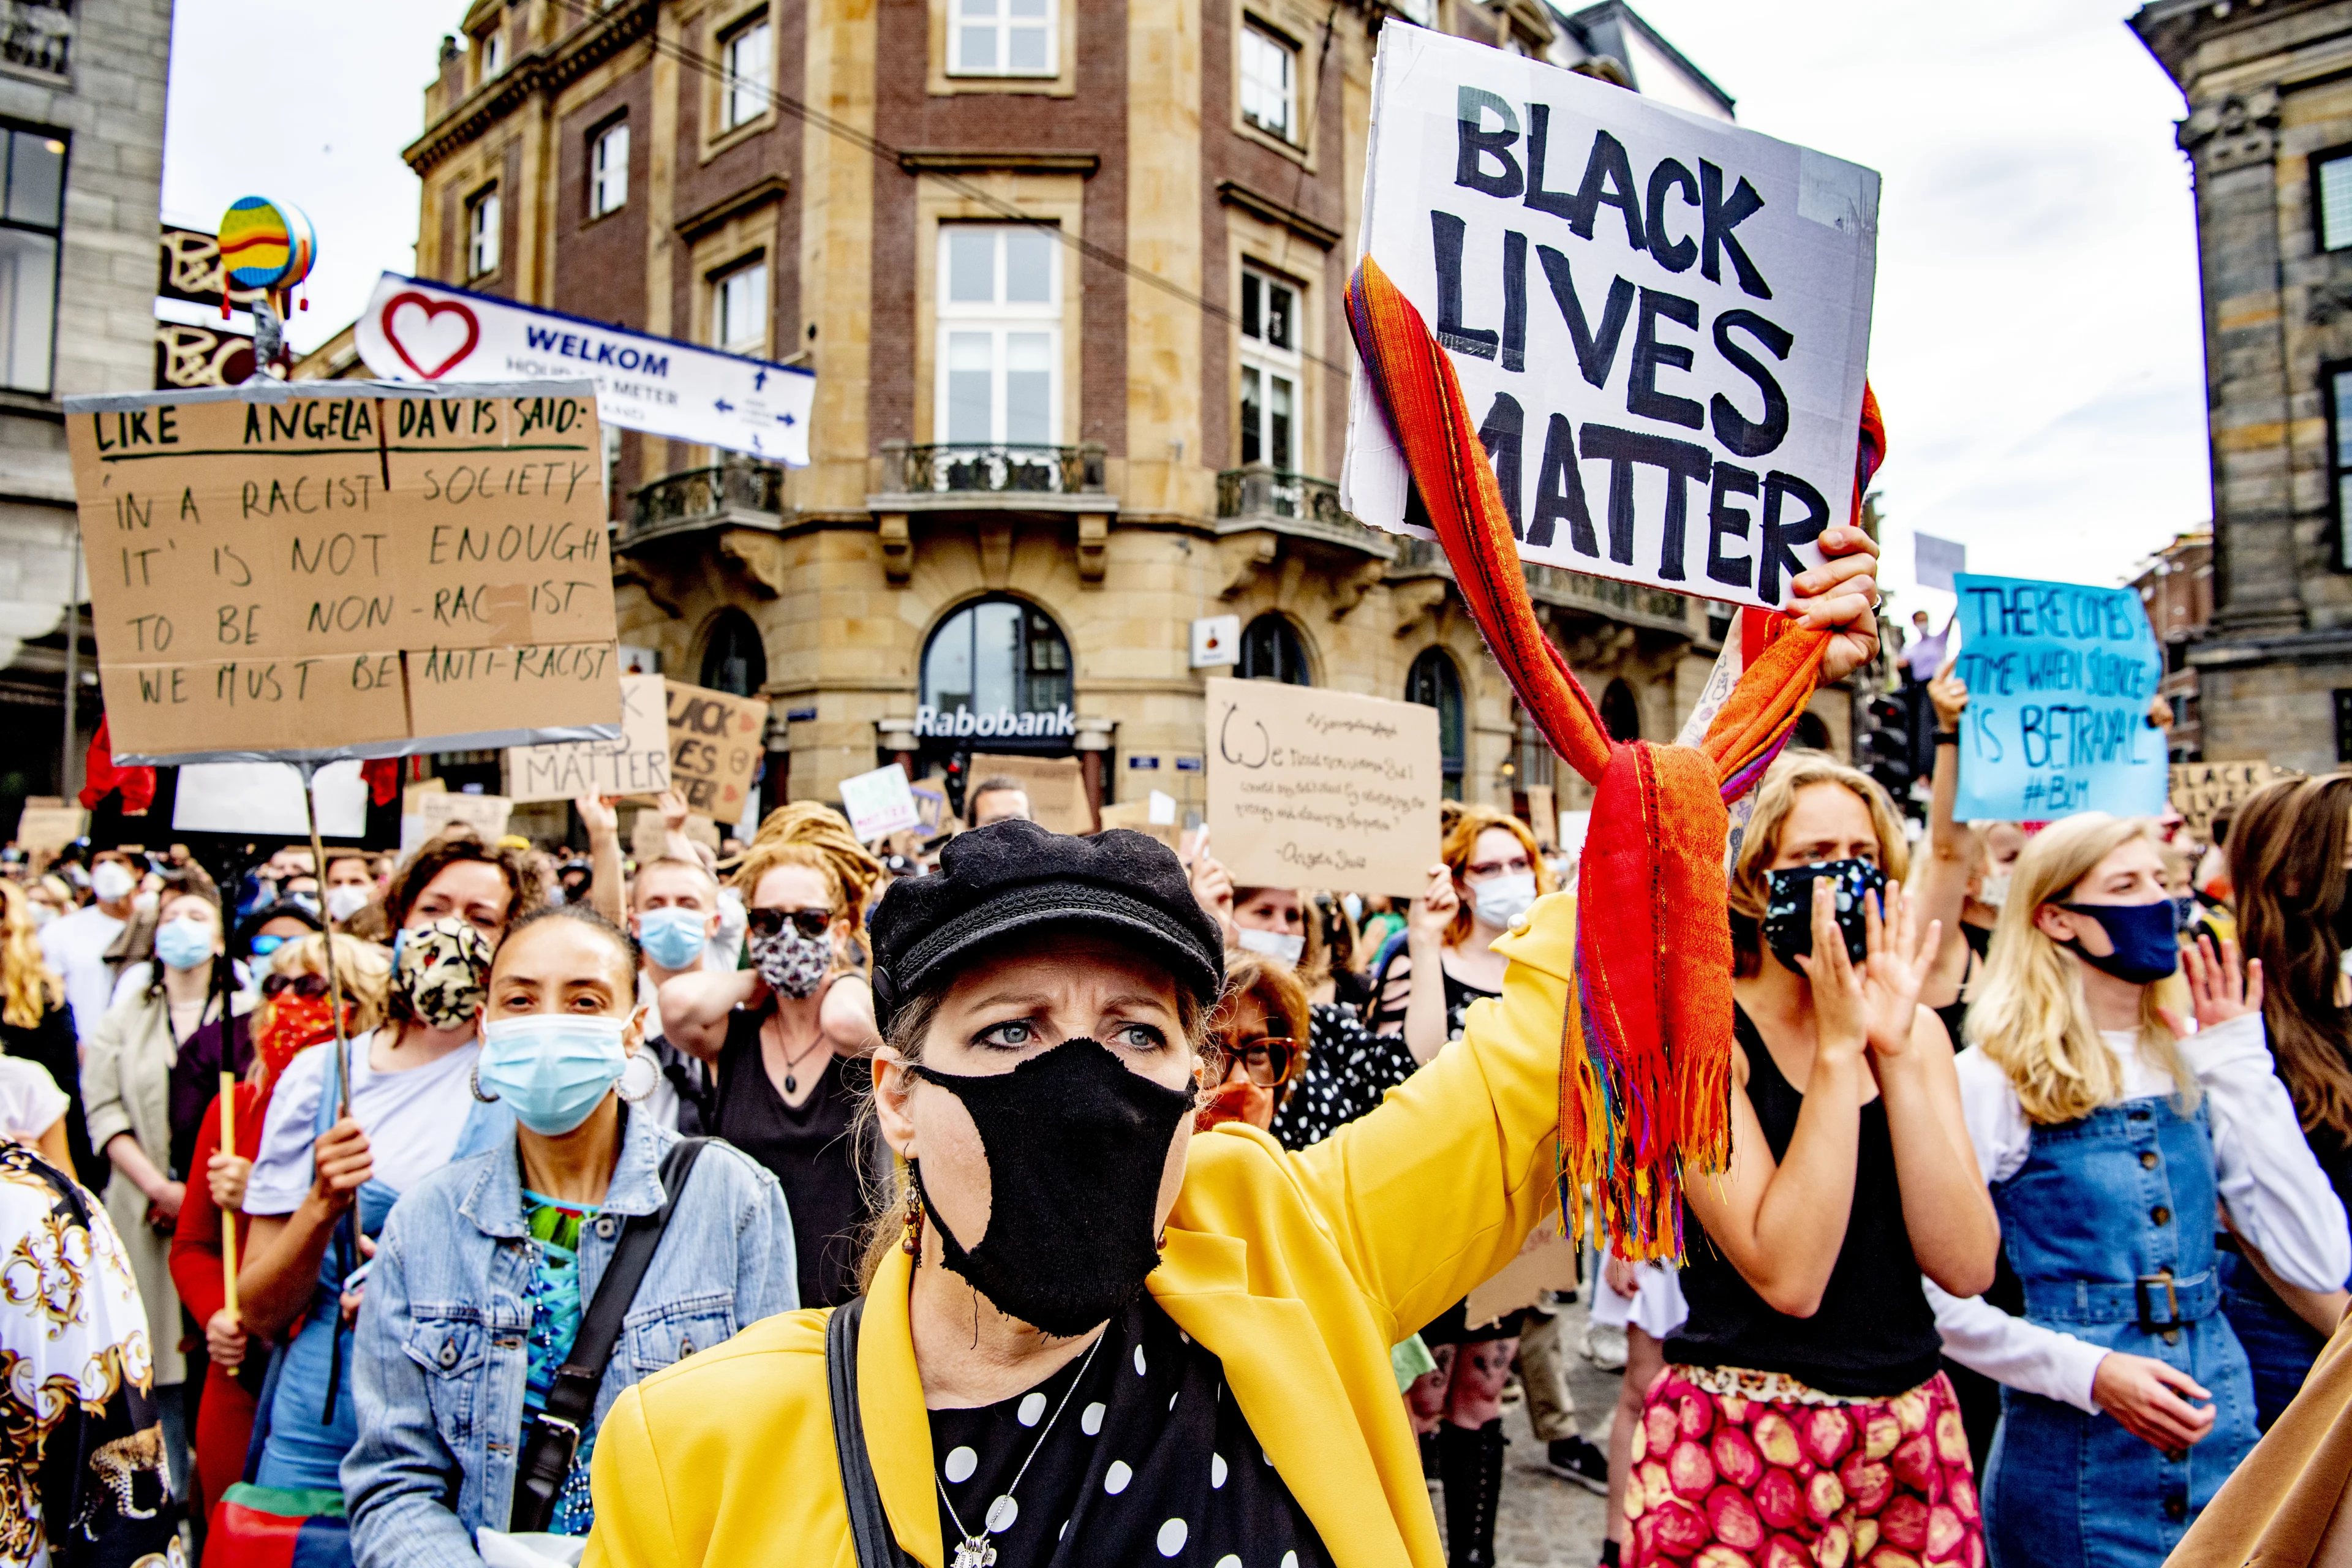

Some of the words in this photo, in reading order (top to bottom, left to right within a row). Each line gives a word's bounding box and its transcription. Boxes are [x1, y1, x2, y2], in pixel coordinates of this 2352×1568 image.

[1454, 85, 1773, 300] BLACK
[527, 325, 669, 377] WELKOM
[1431, 210, 1794, 458] LIVES
[614, 381, 679, 405] METER
[93, 405, 179, 451] LIKE
[243, 398, 372, 445] ANGELA
[399, 398, 496, 438] DAVIS
[513, 398, 587, 437] SAID:
[181, 486, 200, 524] A
[243, 475, 375, 519] RACIST
[423, 461, 589, 504] SOCIETY
[214, 544, 252, 587] IS
[292, 532, 388, 576] NOT
[430, 522, 599, 564] ENOUGH
[126, 614, 173, 652] TO
[217, 604, 262, 645] BE
[1964, 586, 2070, 637] THERE
[138, 668, 188, 704] WE
[217, 658, 324, 707] MUST
[351, 652, 399, 691] BE
[424, 644, 611, 683] ANTI-RACIST
[1963, 651, 2018, 696] TIME
[2024, 649, 2084, 691] WHEN
[666, 691, 734, 738] LACK
[913, 703, 1077, 737] Rabobank
[1971, 703, 2003, 763] IS
[2021, 704, 2149, 770] BETRAYAL
[526, 751, 668, 794] MATTER
[2022, 774, 2090, 812] #BLM
